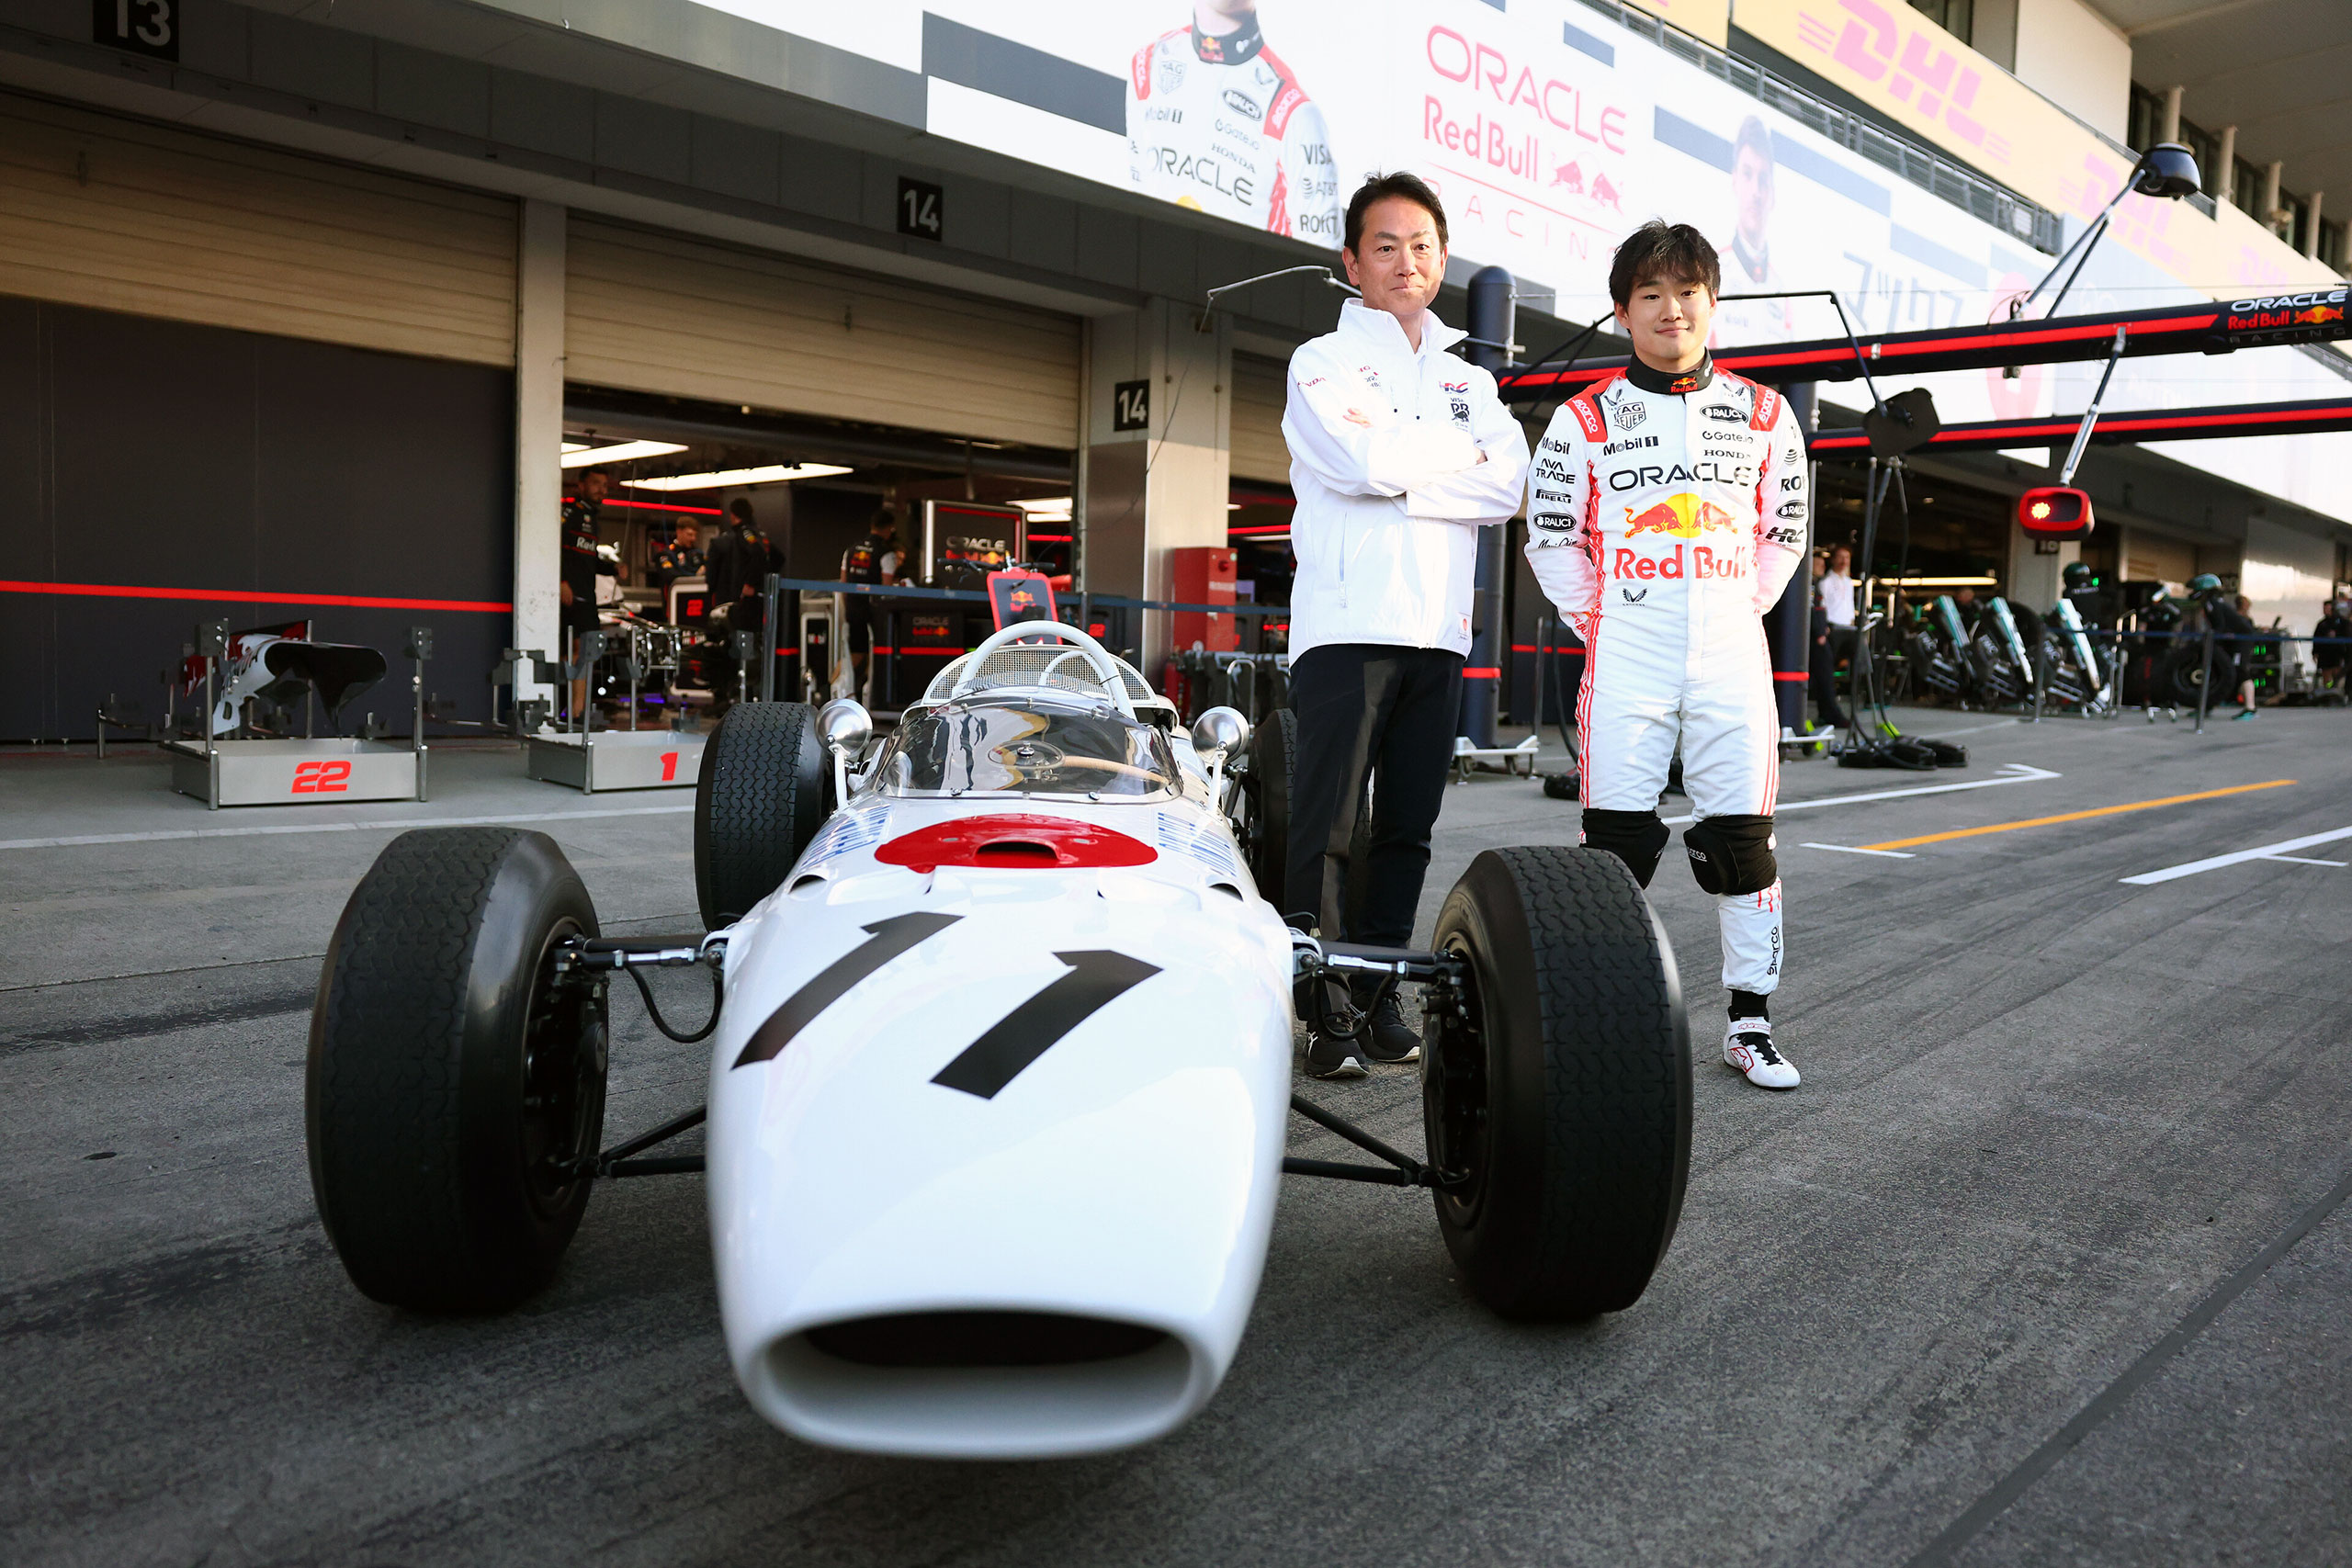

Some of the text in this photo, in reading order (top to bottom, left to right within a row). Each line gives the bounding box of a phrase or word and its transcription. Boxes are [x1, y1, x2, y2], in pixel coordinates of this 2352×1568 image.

[117, 0, 171, 46] 13
[1427, 25, 1626, 155] ORACLE
[1833, 0, 1988, 147] DHL
[1424, 94, 1539, 182] Red Bull
[1211, 142, 1257, 175] HONDA
[904, 189, 939, 232] 14
[2231, 289, 2348, 311] ORACLE
[2228, 310, 2290, 330] Red Bull
[1685, 383, 1699, 392] Bull
[1118, 389, 1147, 424] 14
[1573, 399, 1599, 434] sparco
[1603, 437, 1643, 457] Mobil
[1714, 432, 1754, 444] Gate.io
[1536, 468, 1576, 484] TRADE
[1541, 458, 1565, 472] AVA
[1610, 462, 1752, 491] ORACLE
[1535, 489, 1572, 503] PIRELLI
[1613, 545, 1746, 581] Red Bull
[291, 761, 351, 794] 22
[660, 751, 678, 781] 1
[729, 911, 1163, 1100] 11
